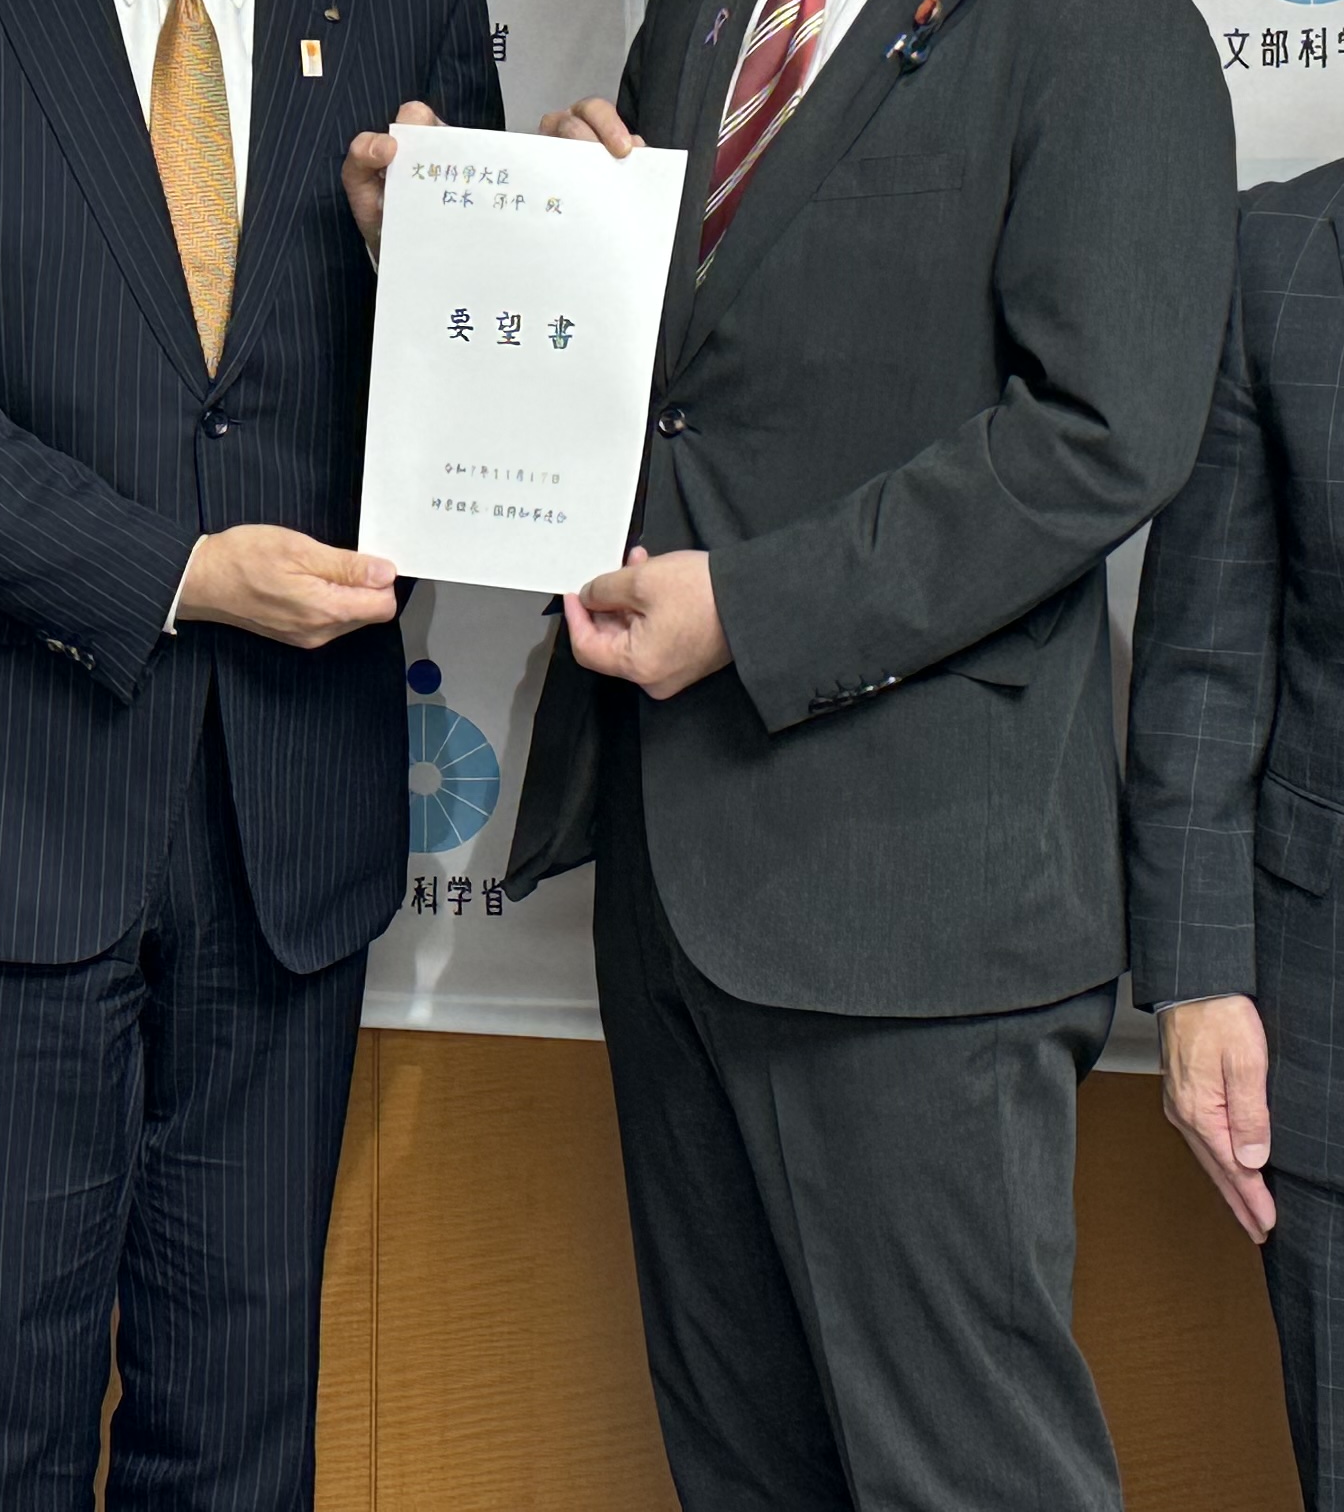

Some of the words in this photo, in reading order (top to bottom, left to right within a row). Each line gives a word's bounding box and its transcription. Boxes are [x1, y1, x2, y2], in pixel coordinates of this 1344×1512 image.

[447, 308, 575, 349] 要望書
[411, 876, 503, 916] 科学省
